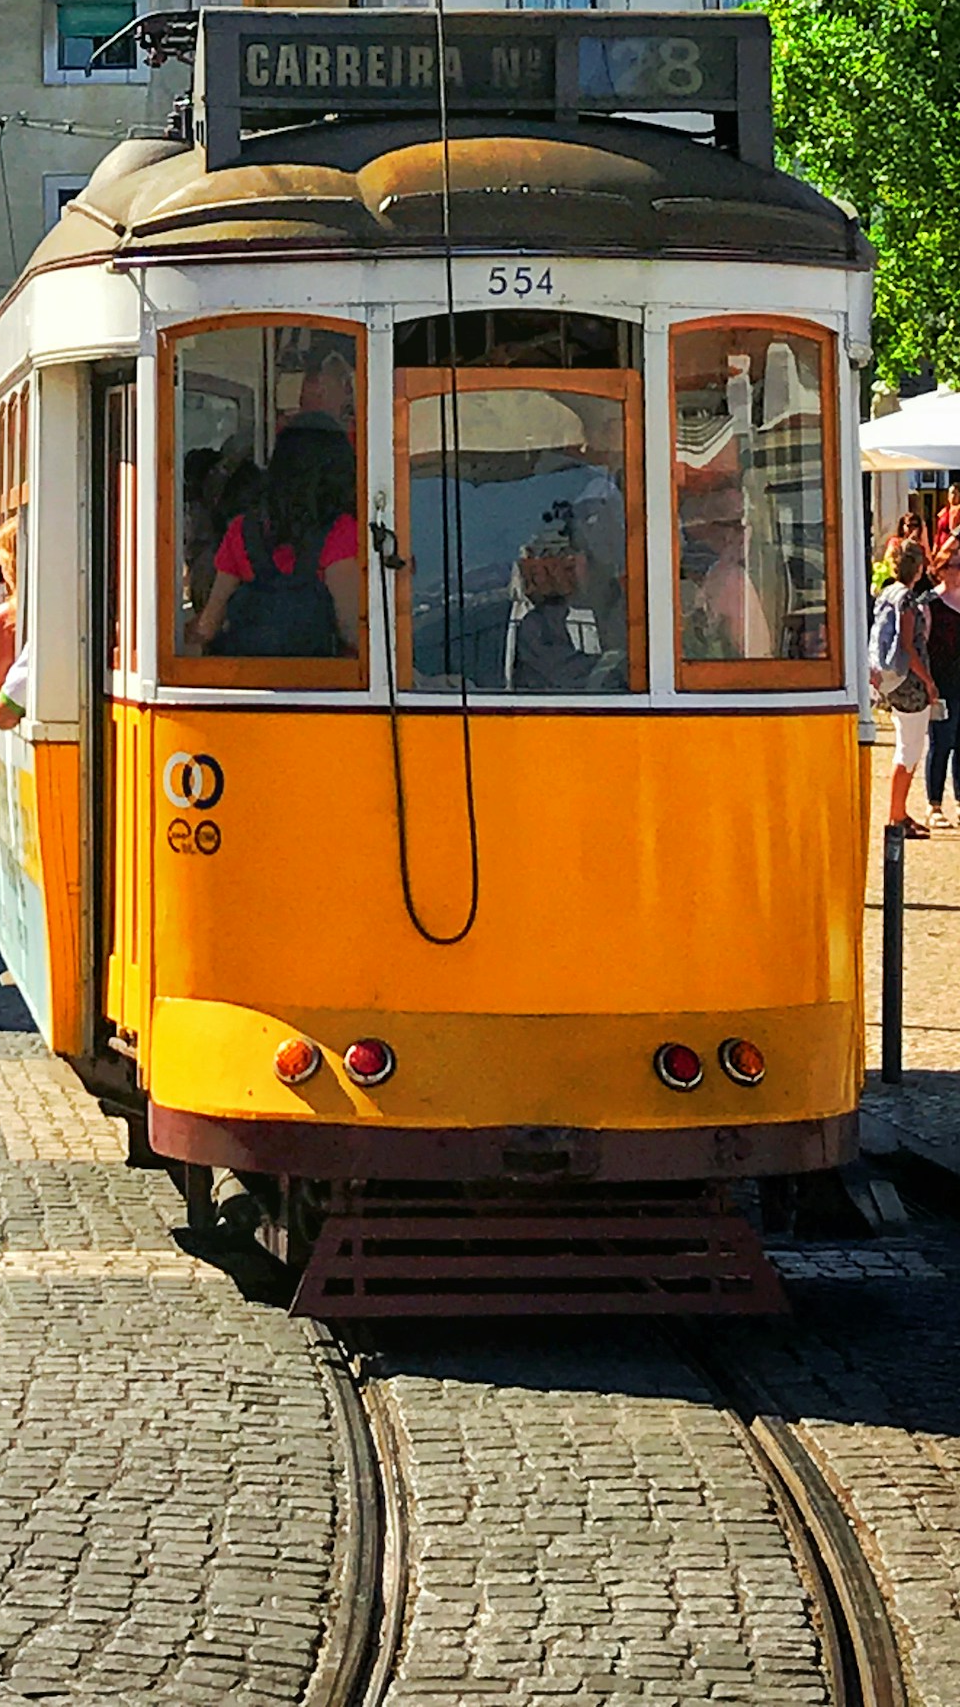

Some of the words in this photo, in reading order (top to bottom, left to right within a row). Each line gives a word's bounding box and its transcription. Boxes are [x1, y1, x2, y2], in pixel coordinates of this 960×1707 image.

[246, 43, 463, 87] CARREIRA
[612, 37, 703, 95] 28
[488, 267, 553, 295] 554
